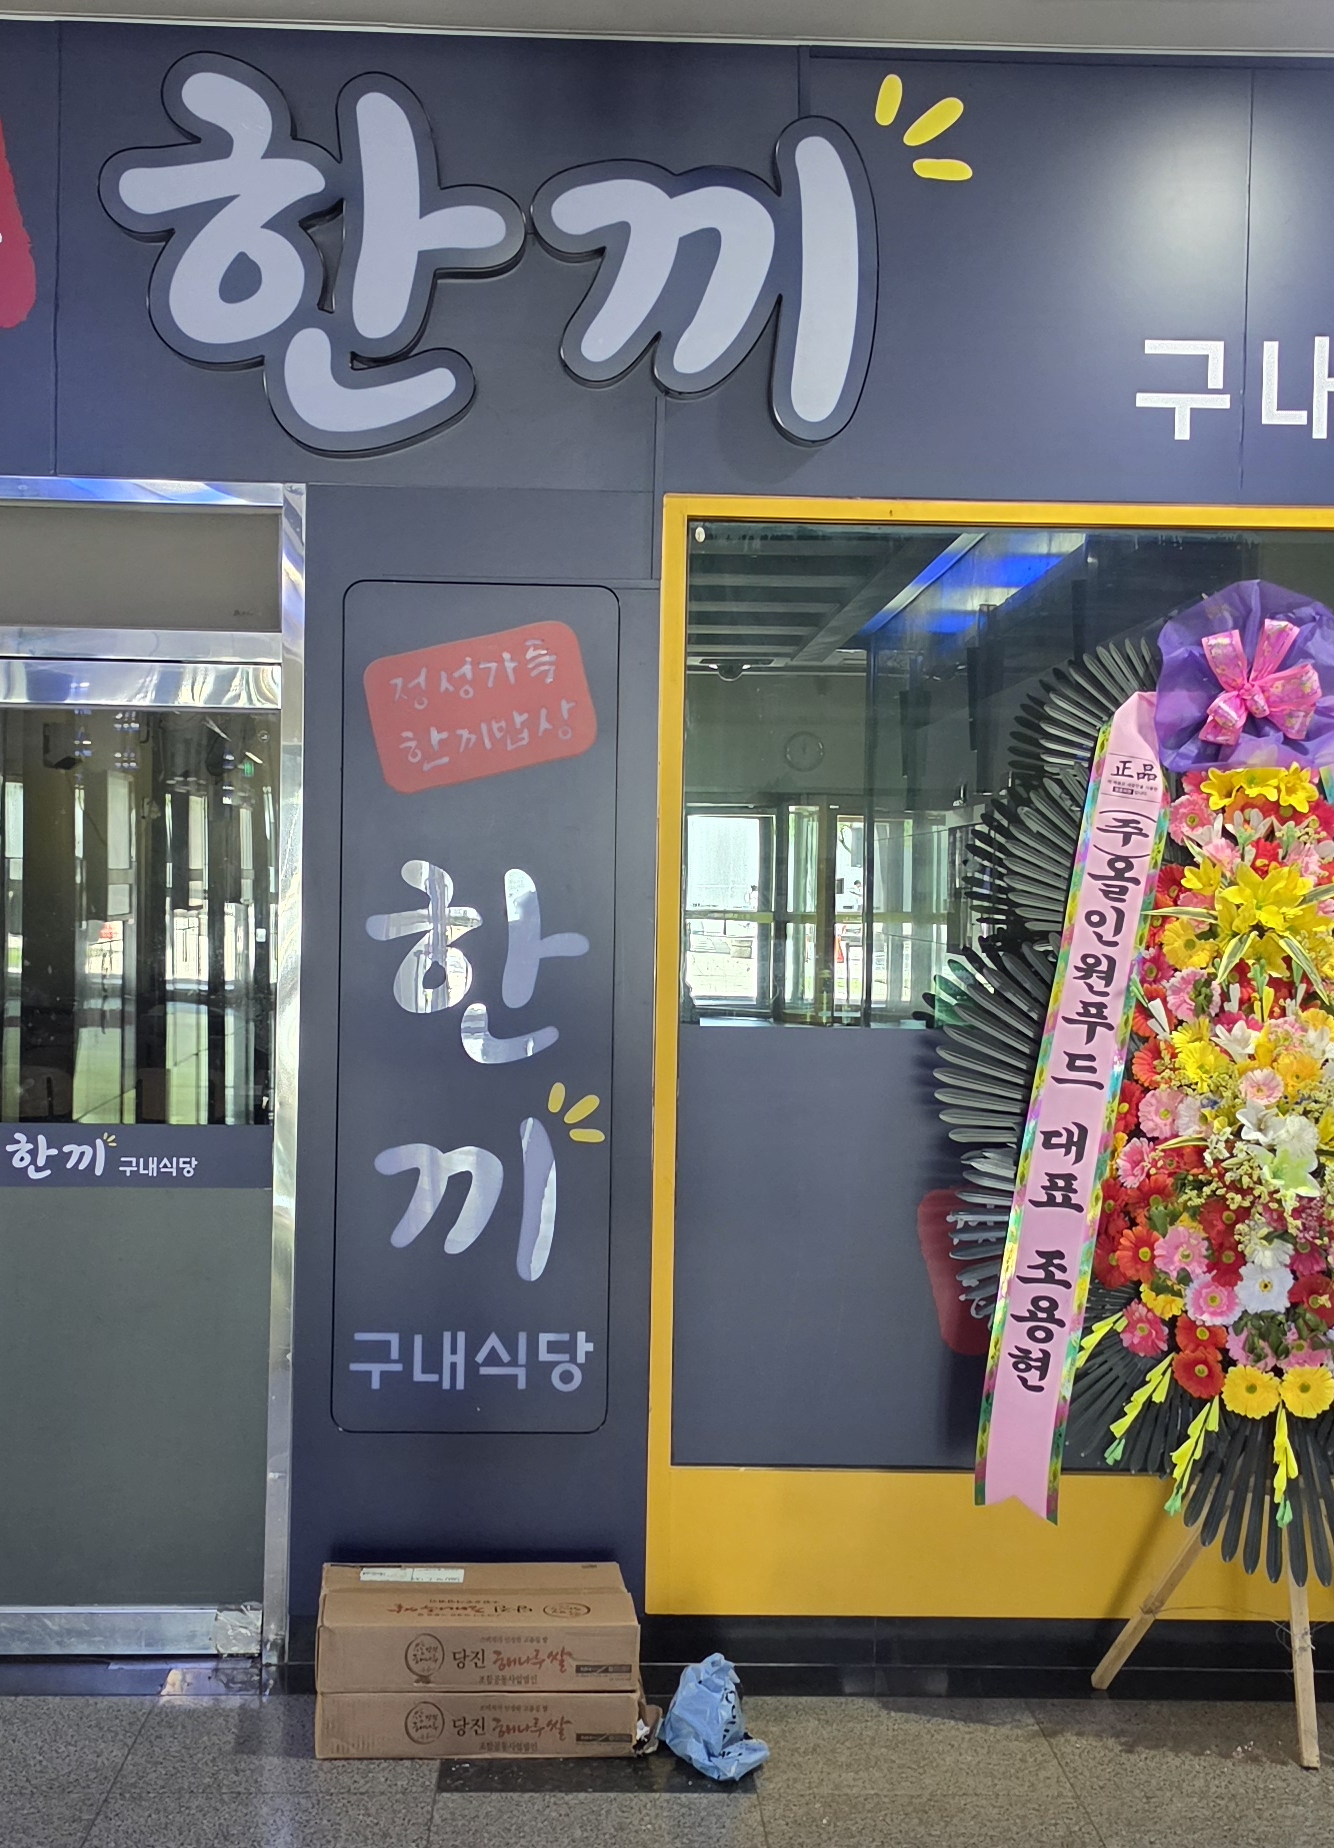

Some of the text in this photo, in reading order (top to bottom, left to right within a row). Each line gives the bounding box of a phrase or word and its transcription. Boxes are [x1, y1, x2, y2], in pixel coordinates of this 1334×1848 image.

[115, 68, 861, 436] 한끼
[389, 639, 557, 710] 정성가득
[399, 698, 577, 772] 한끼밥상
[1110, 760, 1158, 782] 正品
[6, 1132, 199, 1180] 한끼 구내식당
[1028, 1121, 1087, 1215] 대표
[1007, 1249, 1073, 1394] 조용현
[349, 1331, 594, 1395] 구내식당
[452, 1648, 486, 1669] 당진
[452, 1716, 486, 1737] 당진
